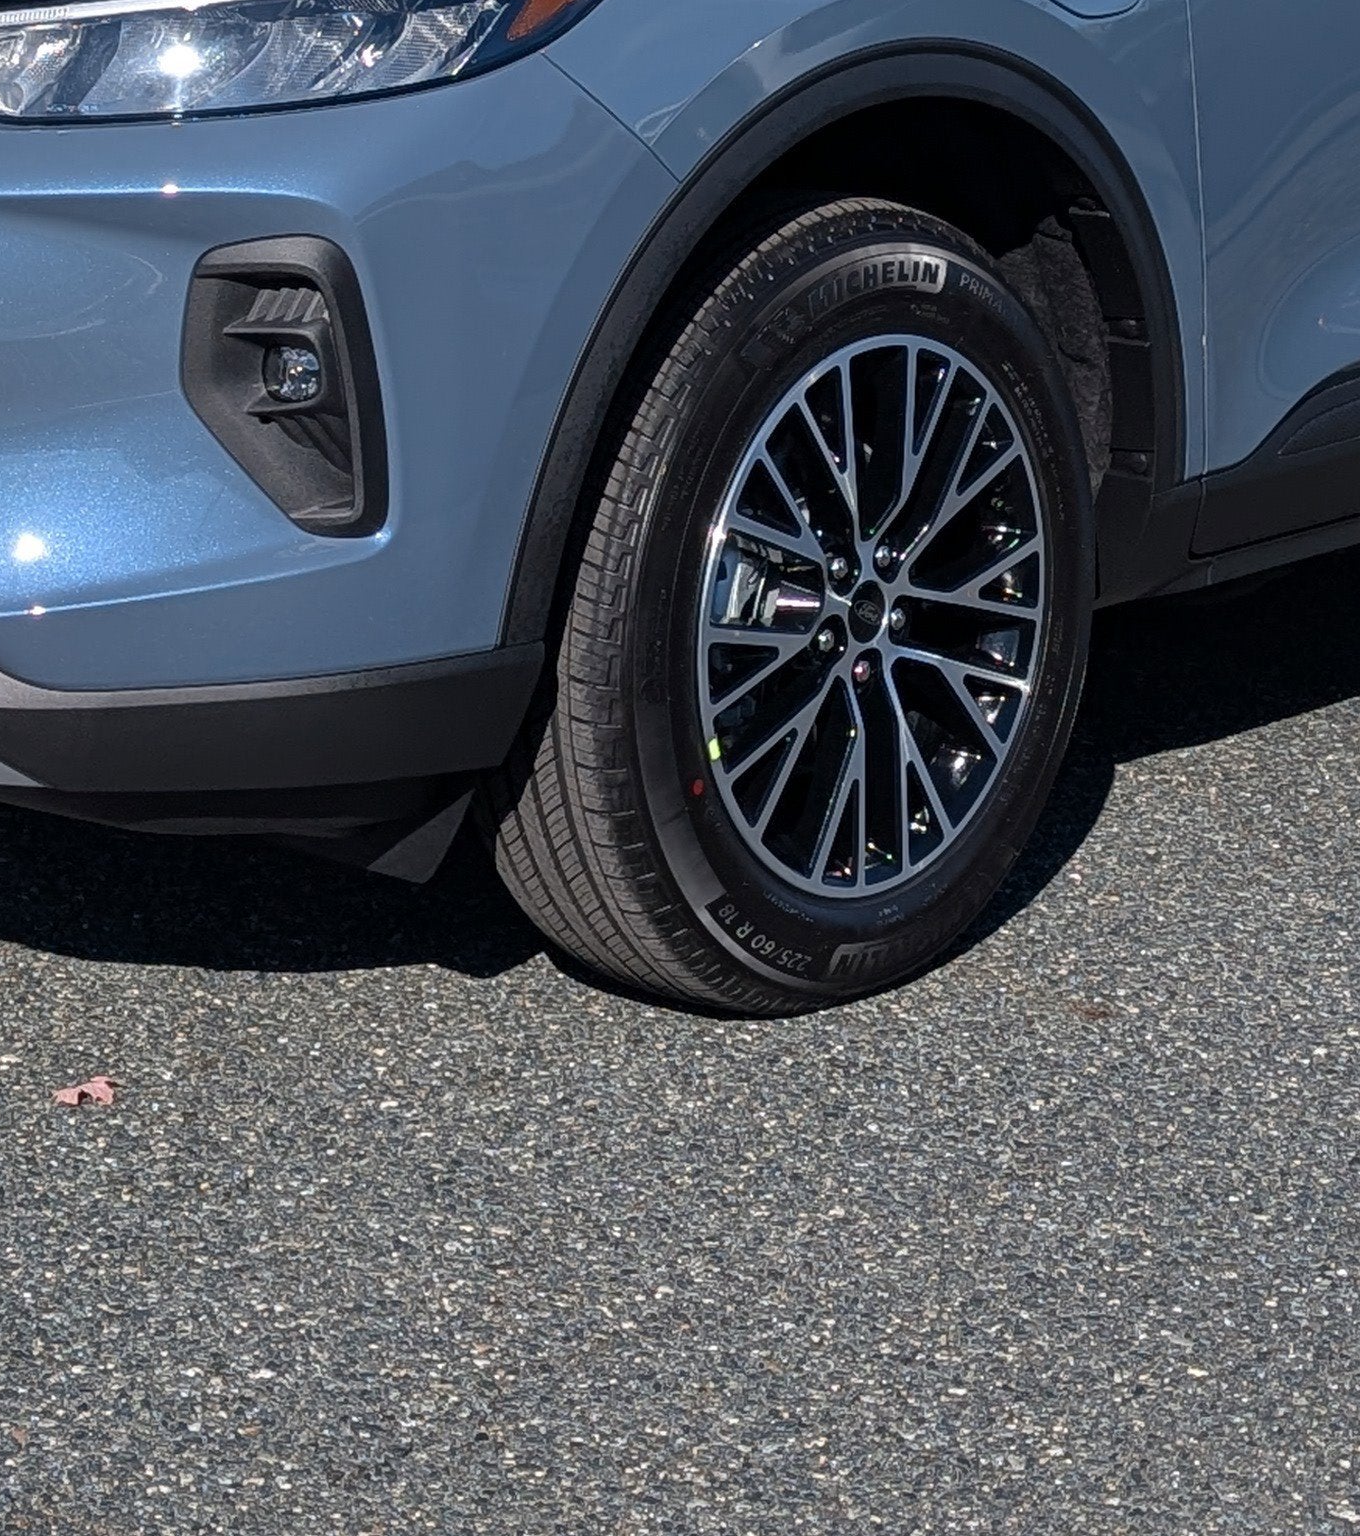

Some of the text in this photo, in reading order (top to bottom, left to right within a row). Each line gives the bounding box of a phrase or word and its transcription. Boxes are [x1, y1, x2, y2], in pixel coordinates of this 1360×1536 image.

[806, 260, 942, 317] MICHELIN
[717, 902, 740, 925] 18
[734, 920, 755, 939] R
[750, 934, 813, 972] 225/60
